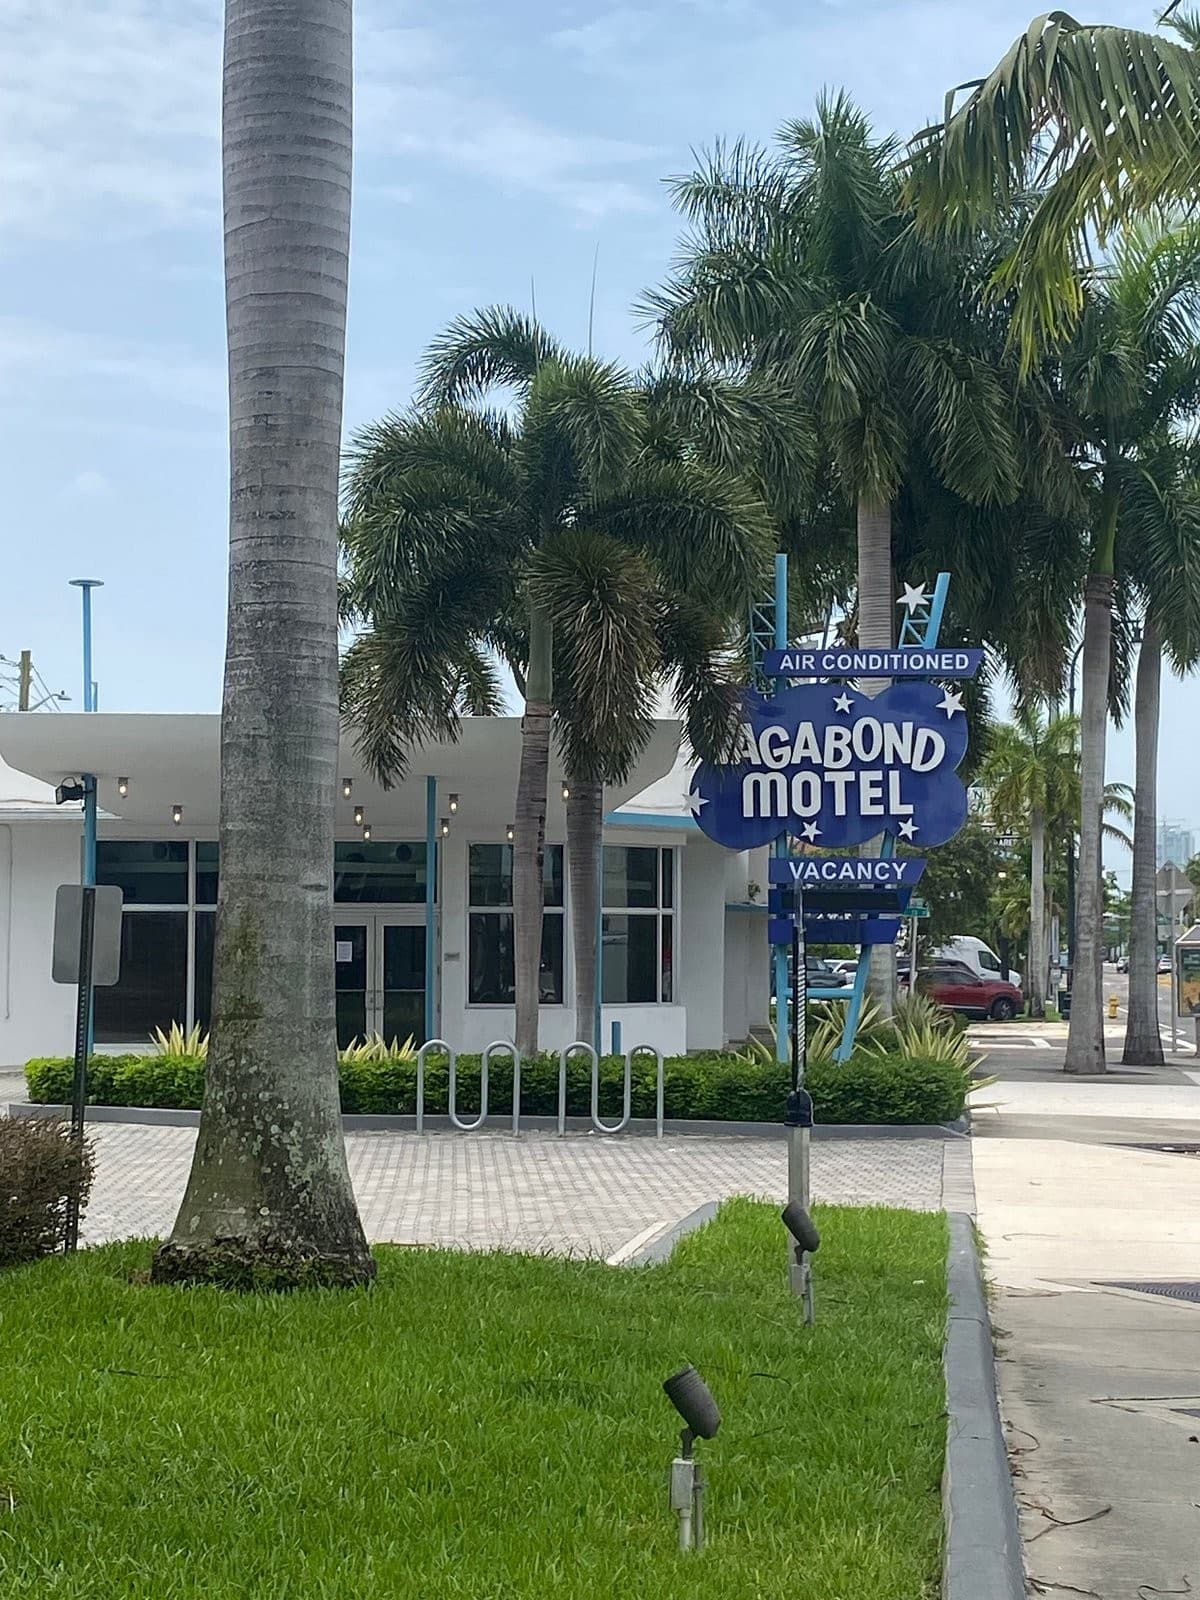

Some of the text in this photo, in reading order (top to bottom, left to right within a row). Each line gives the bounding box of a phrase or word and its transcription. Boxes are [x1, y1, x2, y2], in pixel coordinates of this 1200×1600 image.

[779, 653, 969, 670] AIR CONDITIONED
[742, 769, 914, 818] MOTEL
[788, 861, 908, 880] VACANCY
